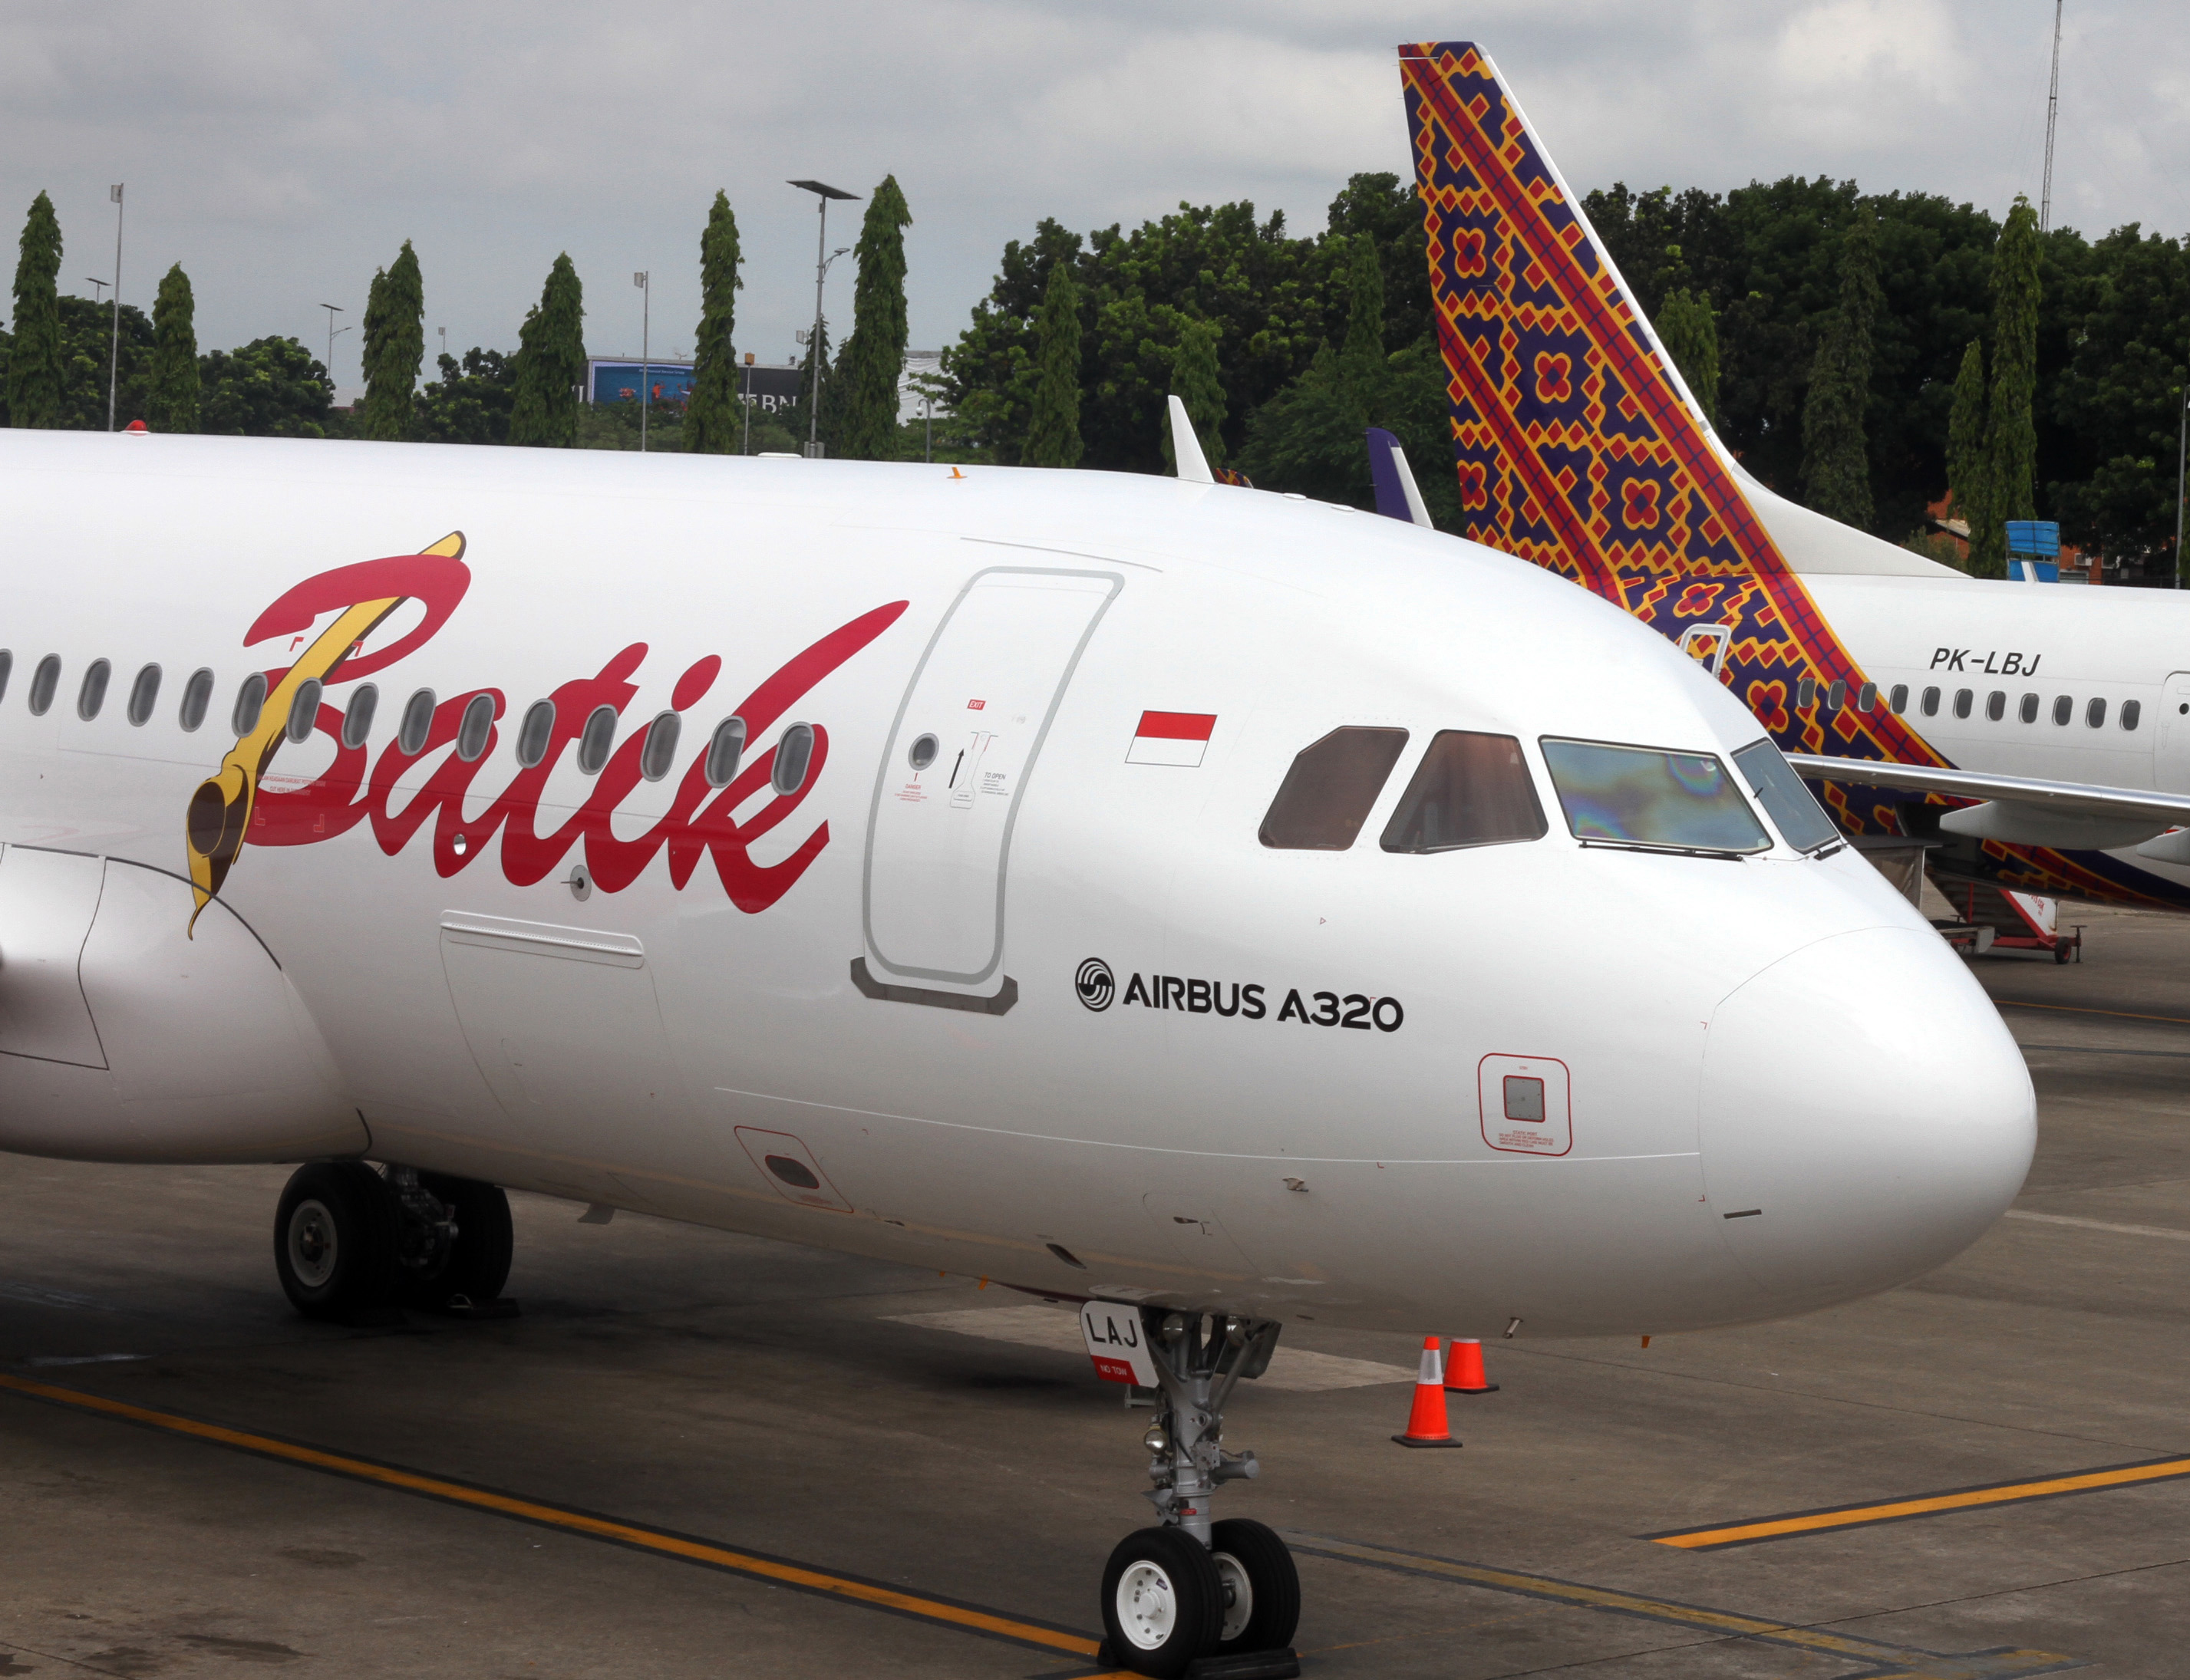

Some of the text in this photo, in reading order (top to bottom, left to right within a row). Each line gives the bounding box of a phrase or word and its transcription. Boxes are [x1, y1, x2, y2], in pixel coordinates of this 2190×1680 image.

[1929, 647, 2041, 677] PK-LBJ
[968, 700, 985, 709] EXIT
[241, 554, 910, 914] Batik
[1122, 973, 1404, 1033] AIRBUS A320
[1085, 1313, 1138, 1348] LAJ
[1100, 1364, 1128, 1376] NO TOW
